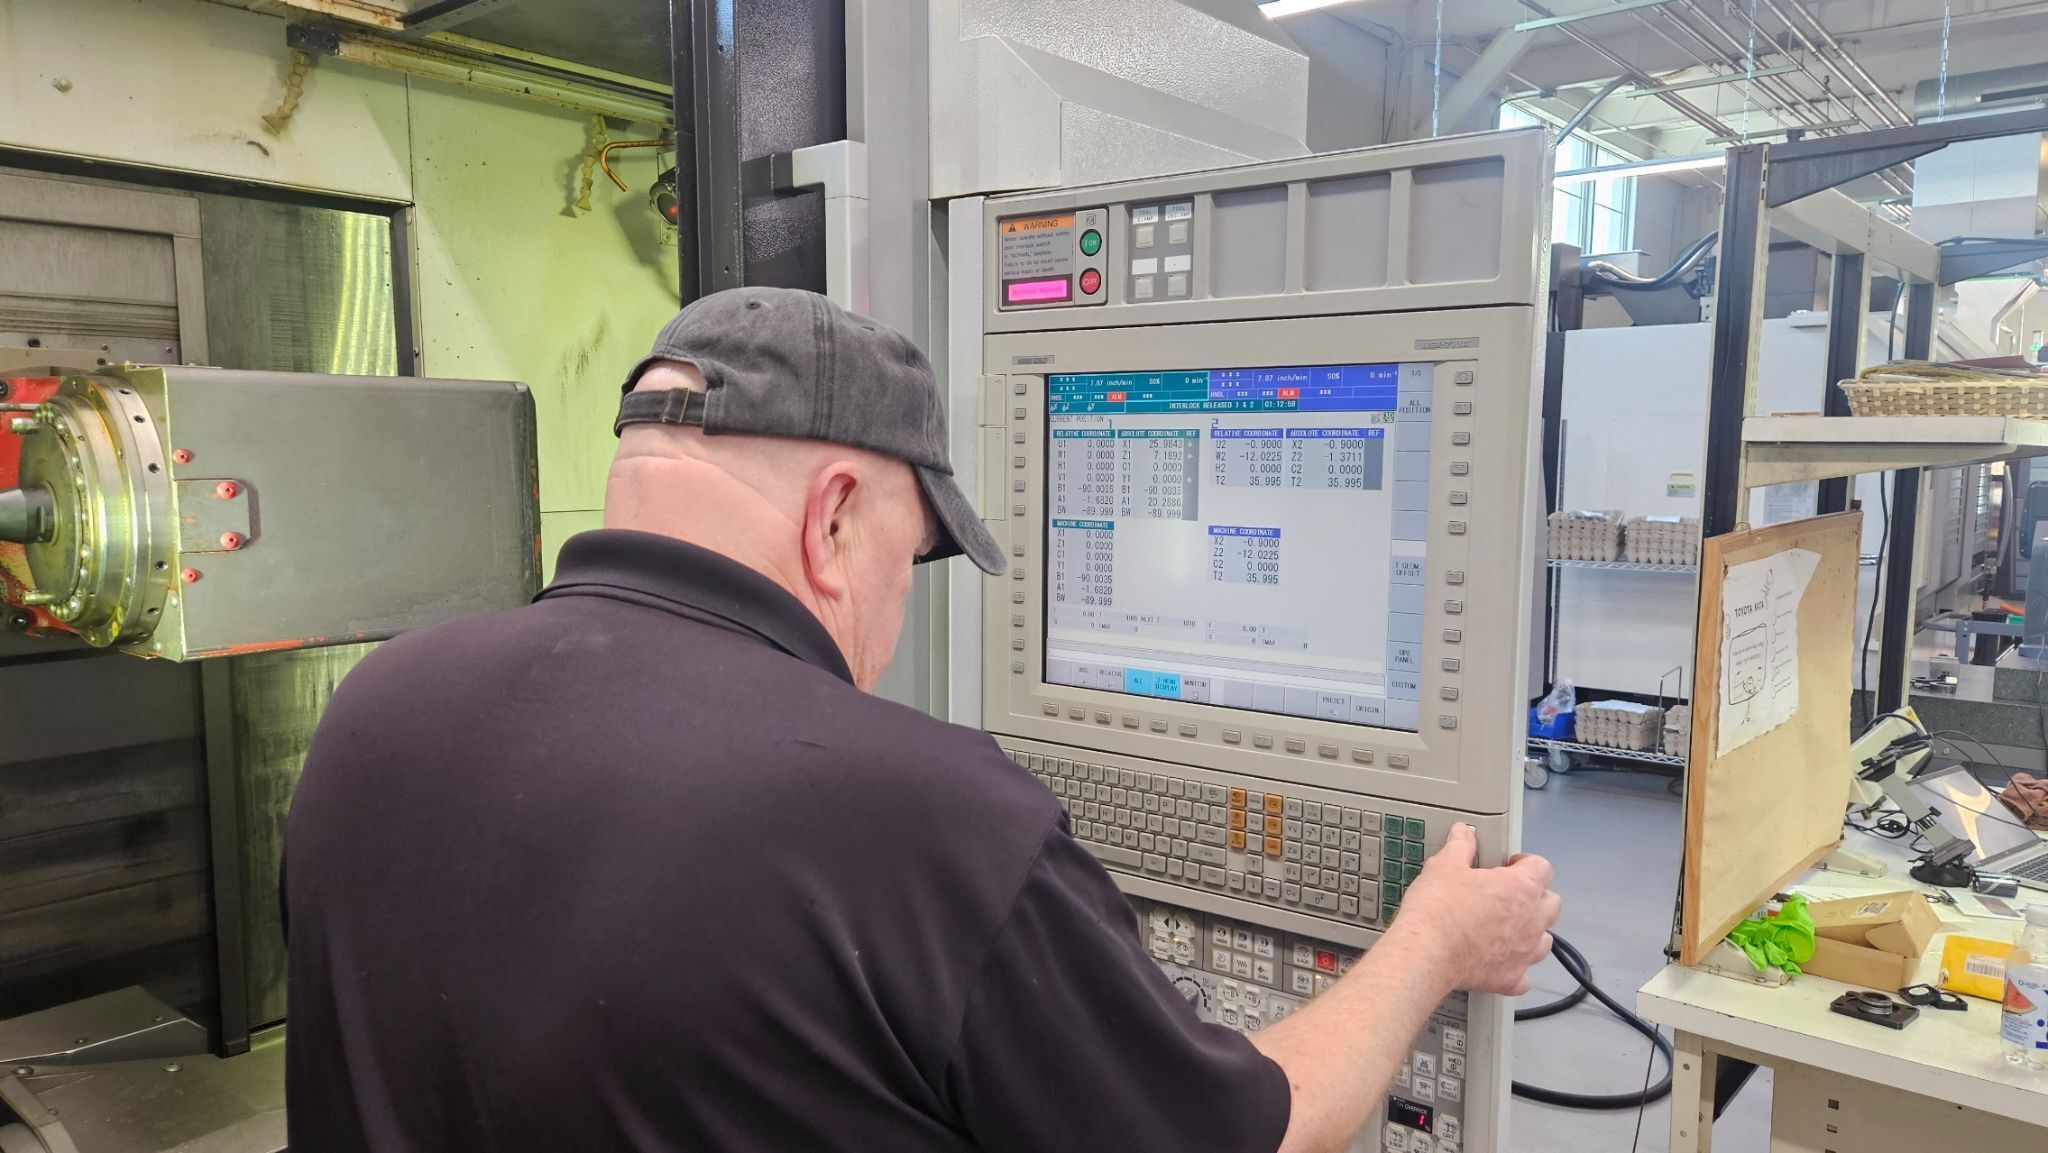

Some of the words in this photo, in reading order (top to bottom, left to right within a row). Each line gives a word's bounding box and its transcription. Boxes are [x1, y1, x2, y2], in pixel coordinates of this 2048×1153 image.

[1023, 219, 1058, 230] WARNING
[1277, 373, 1308, 382] inch/min
[1411, 369, 1422, 377] 1/2
[1281, 389, 1295, 397] ALM
[1202, 401, 1232, 409] RELEASED
[1081, 430, 1112, 438] COORDINATE
[1147, 430, 1180, 438] COORDINATE
[1214, 429, 1242, 437] RELATIVE
[1243, 429, 1279, 437] COORDINATE
[1290, 429, 1320, 437] ABSOLUTE
[1321, 429, 1360, 437] COORDINATE
[1367, 429, 1380, 437] REF
[1245, 439, 1283, 449] -0.9000
[1291, 439, 1303, 450] X2
[1323, 439, 1364, 450] -0.9000
[1122, 451, 1131, 460] Z1
[1215, 451, 1227, 461] W2
[1239, 452, 1282, 462] -12.0225
[1291, 452, 1303, 462] Z2
[1322, 453, 1363, 463] -1.3711
[1152, 462, 1183, 472] 0.0000
[1215, 463, 1226, 473] H2
[1249, 464, 1282, 474] 0.0000
[1291, 464, 1303, 474] C2
[1327, 465, 1363, 475] 0.0000
[1122, 473, 1131, 483] Y1
[1152, 474, 1182, 484] 0.0000
[1215, 475, 1226, 485] T2
[1249, 476, 1282, 487] 35.995
[1291, 477, 1302, 487] T2
[1327, 477, 1362, 488] 35.995
[1057, 483, 1066, 492] B1
[1121, 485, 1131, 494] B1
[1057, 494, 1066, 503] A1
[1121, 496, 1131, 506] A1
[1056, 520, 1077, 528] MACHINE
[1079, 520, 1108, 529] COORDINATE
[1057, 528, 1065, 537] X1
[1086, 530, 1114, 539] 0.0000
[1213, 527, 1239, 536] MACHINE
[1239, 528, 1274, 537] COORDINATE
[1057, 539, 1065, 548] Z1
[1214, 536, 1224, 546] X2
[1242, 537, 1280, 547] -0.9000
[1057, 550, 1065, 559] C1
[1085, 552, 1114, 561] 0.0000
[1213, 547, 1224, 557] Z2
[1236, 550, 1279, 560] -12.0225
[1057, 561, 1065, 570] Y1
[1085, 562, 1113, 572] 0.0000
[1213, 559, 1224, 569] C2
[1247, 562, 1279, 572] 0.0000
[1056, 572, 1065, 581] B1
[1077, 573, 1113, 584] -90.0035
[1213, 571, 1223, 581] T2
[1246, 573, 1279, 584] 35.995
[1056, 583, 1065, 592] A1
[1081, 596, 1113, 606] -89.999
[1734, 605, 1753, 618] TOYOTA
[1394, 656, 1415, 664] PANEL
[1155, 684, 1178, 692] DISPLAY
[1391, 681, 1417, 690] CUSTOM
[1322, 696, 1345, 705] PRESET
[1355, 705, 1380, 714] ORIGIN
[1404, 1103, 1429, 1115] OVERRIDE
